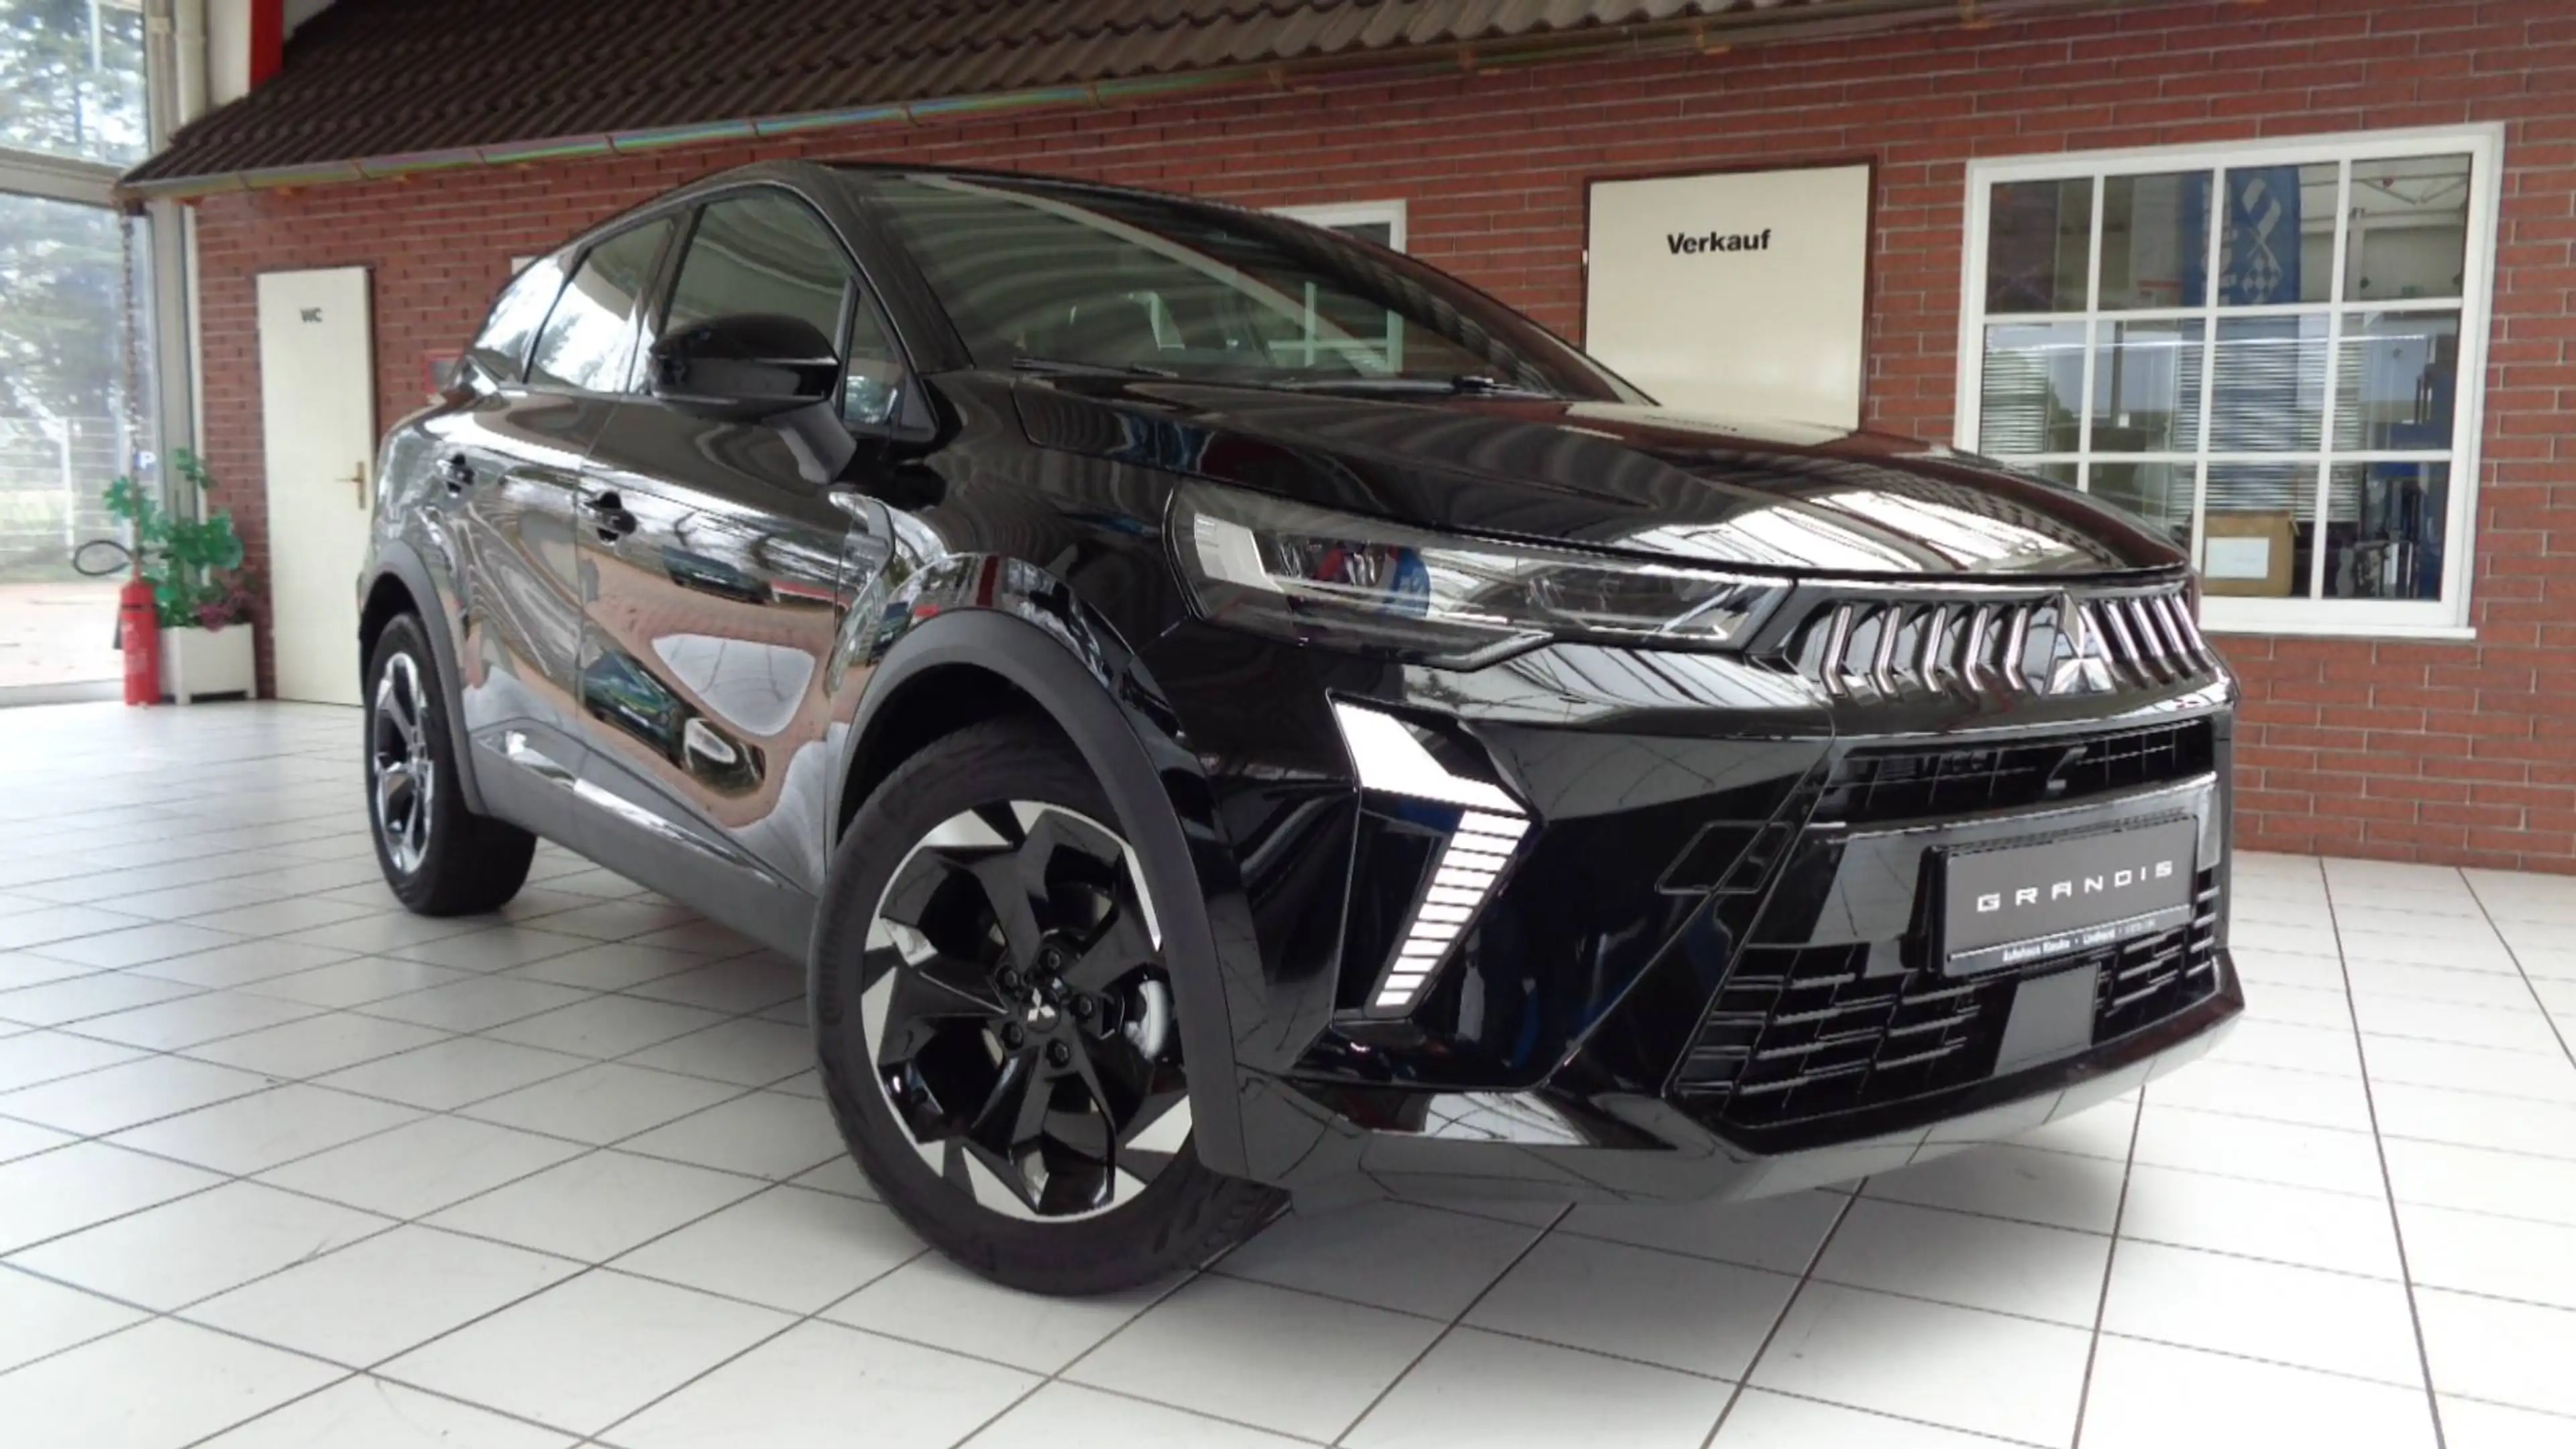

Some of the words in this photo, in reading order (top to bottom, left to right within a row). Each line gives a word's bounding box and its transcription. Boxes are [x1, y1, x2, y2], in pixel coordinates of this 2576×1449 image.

[1667, 229, 1772, 254] Verkauf
[300, 307, 323, 323] WC
[140, 451, 156, 470] P
[1976, 860, 2174, 913] GRANDIS
